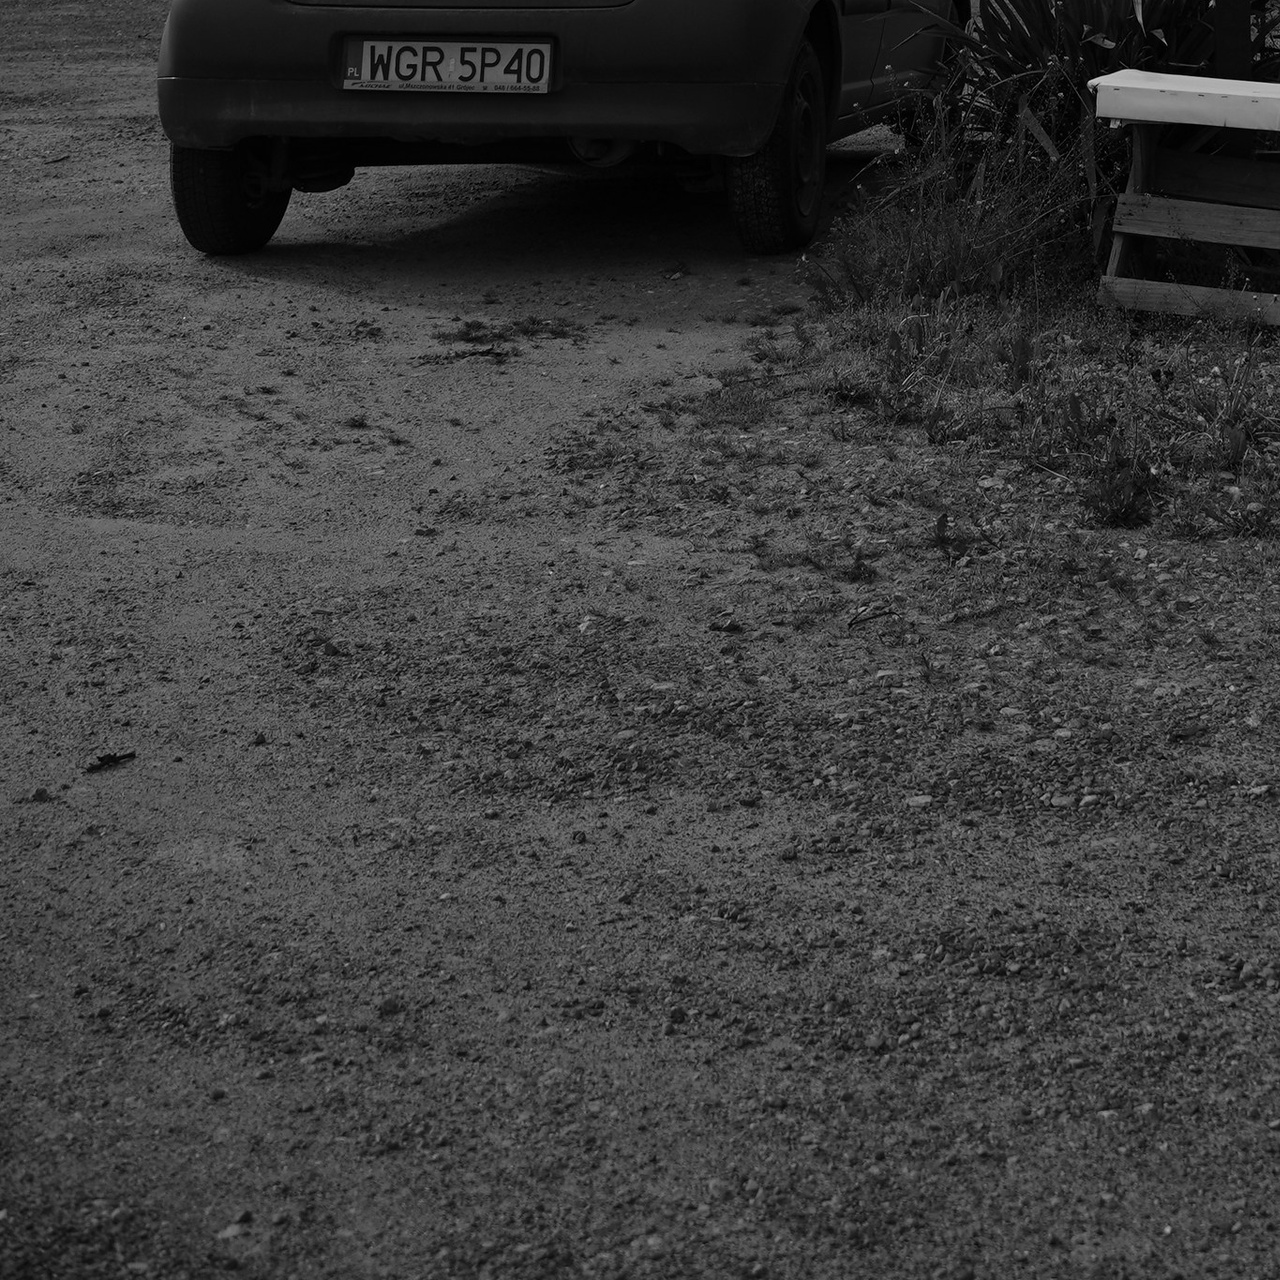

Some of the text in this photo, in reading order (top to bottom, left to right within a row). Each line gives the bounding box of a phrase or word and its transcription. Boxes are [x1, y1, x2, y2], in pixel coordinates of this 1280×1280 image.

[347, 67, 360, 77] PL
[370, 45, 545, 84] WGR 5P40
